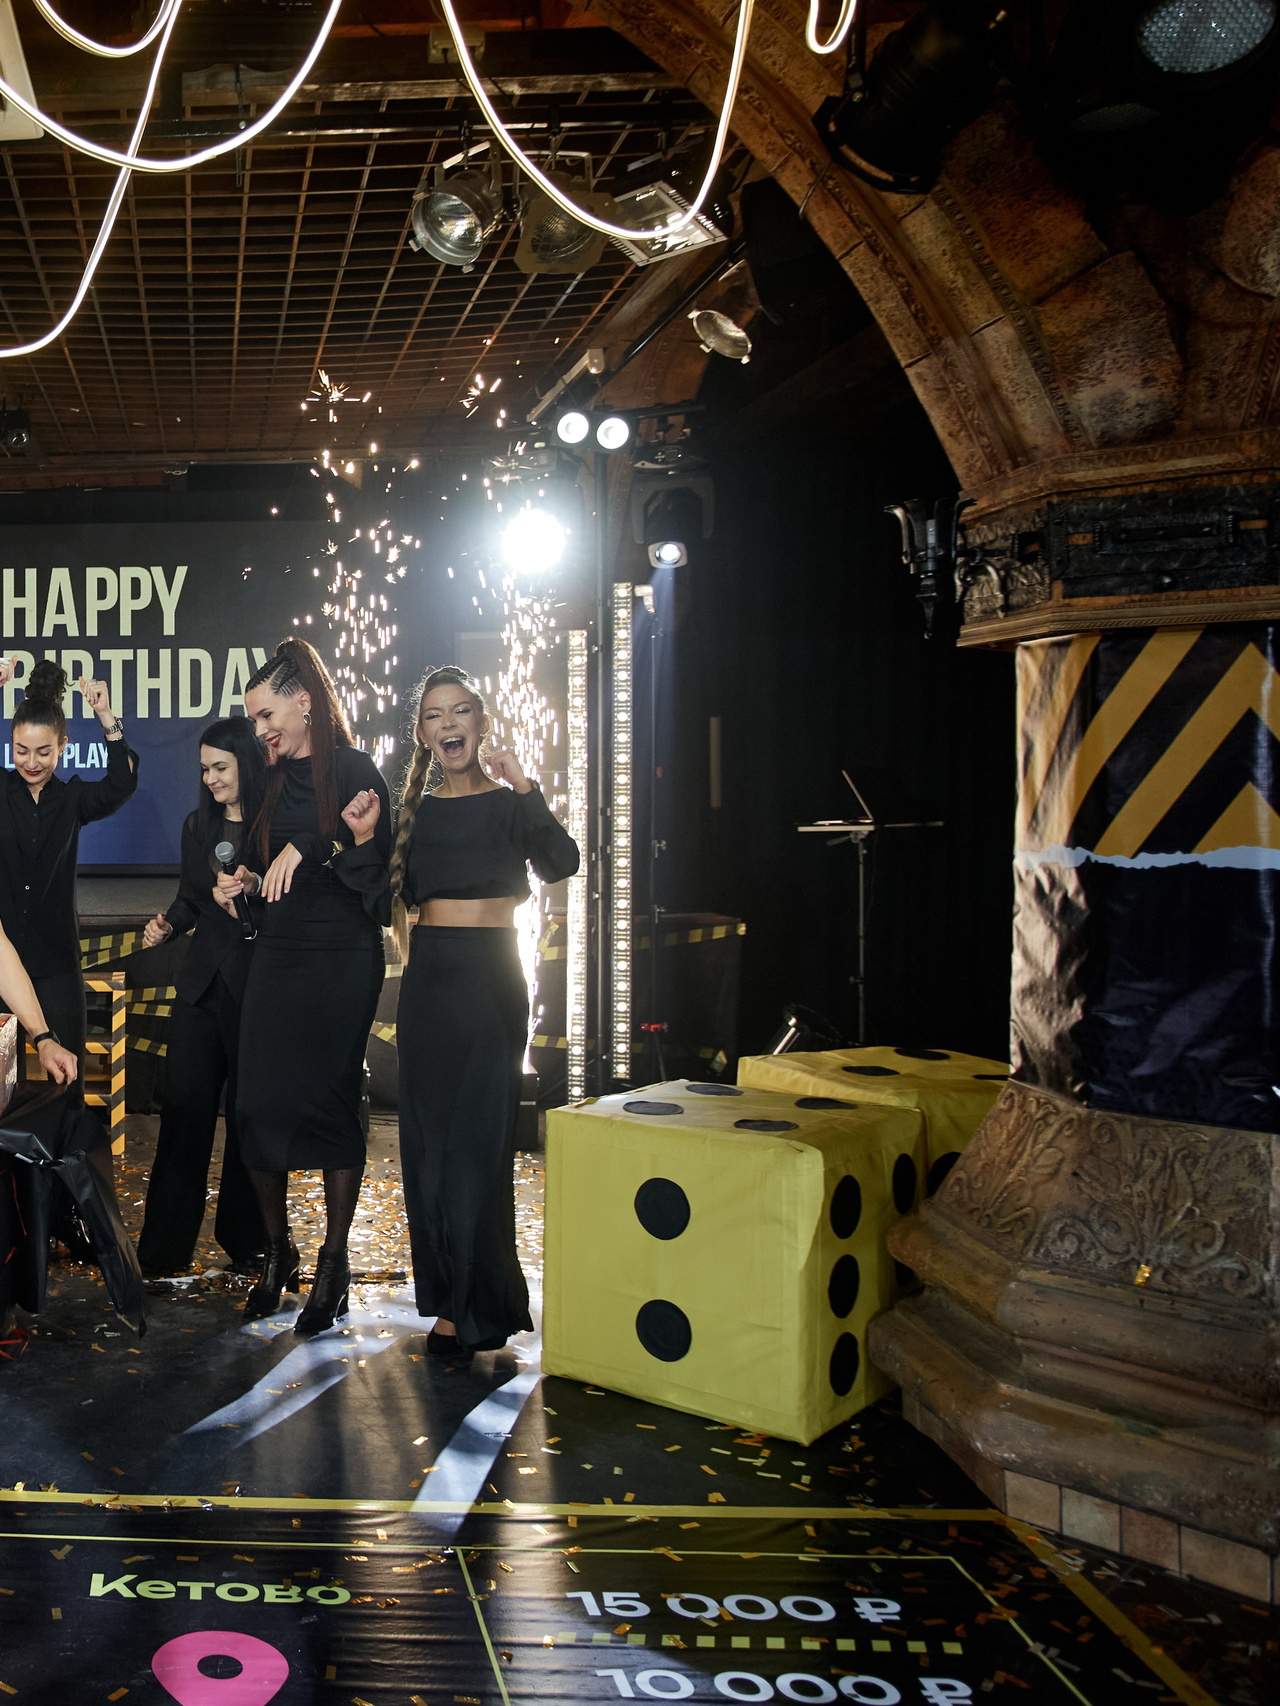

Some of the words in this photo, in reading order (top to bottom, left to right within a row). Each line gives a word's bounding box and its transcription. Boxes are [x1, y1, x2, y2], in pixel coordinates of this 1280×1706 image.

[2, 565, 188, 638] HAPPY
[2, 647, 273, 720] BRTHDA
[62, 742, 109, 769] PLAY
[89, 1573, 351, 1605] Кетово
[566, 1591, 651, 1618] 15
[666, 1592, 837, 1622] 000
[595, 1668, 696, 1700] 10
[713, 1671, 902, 1706] 000
